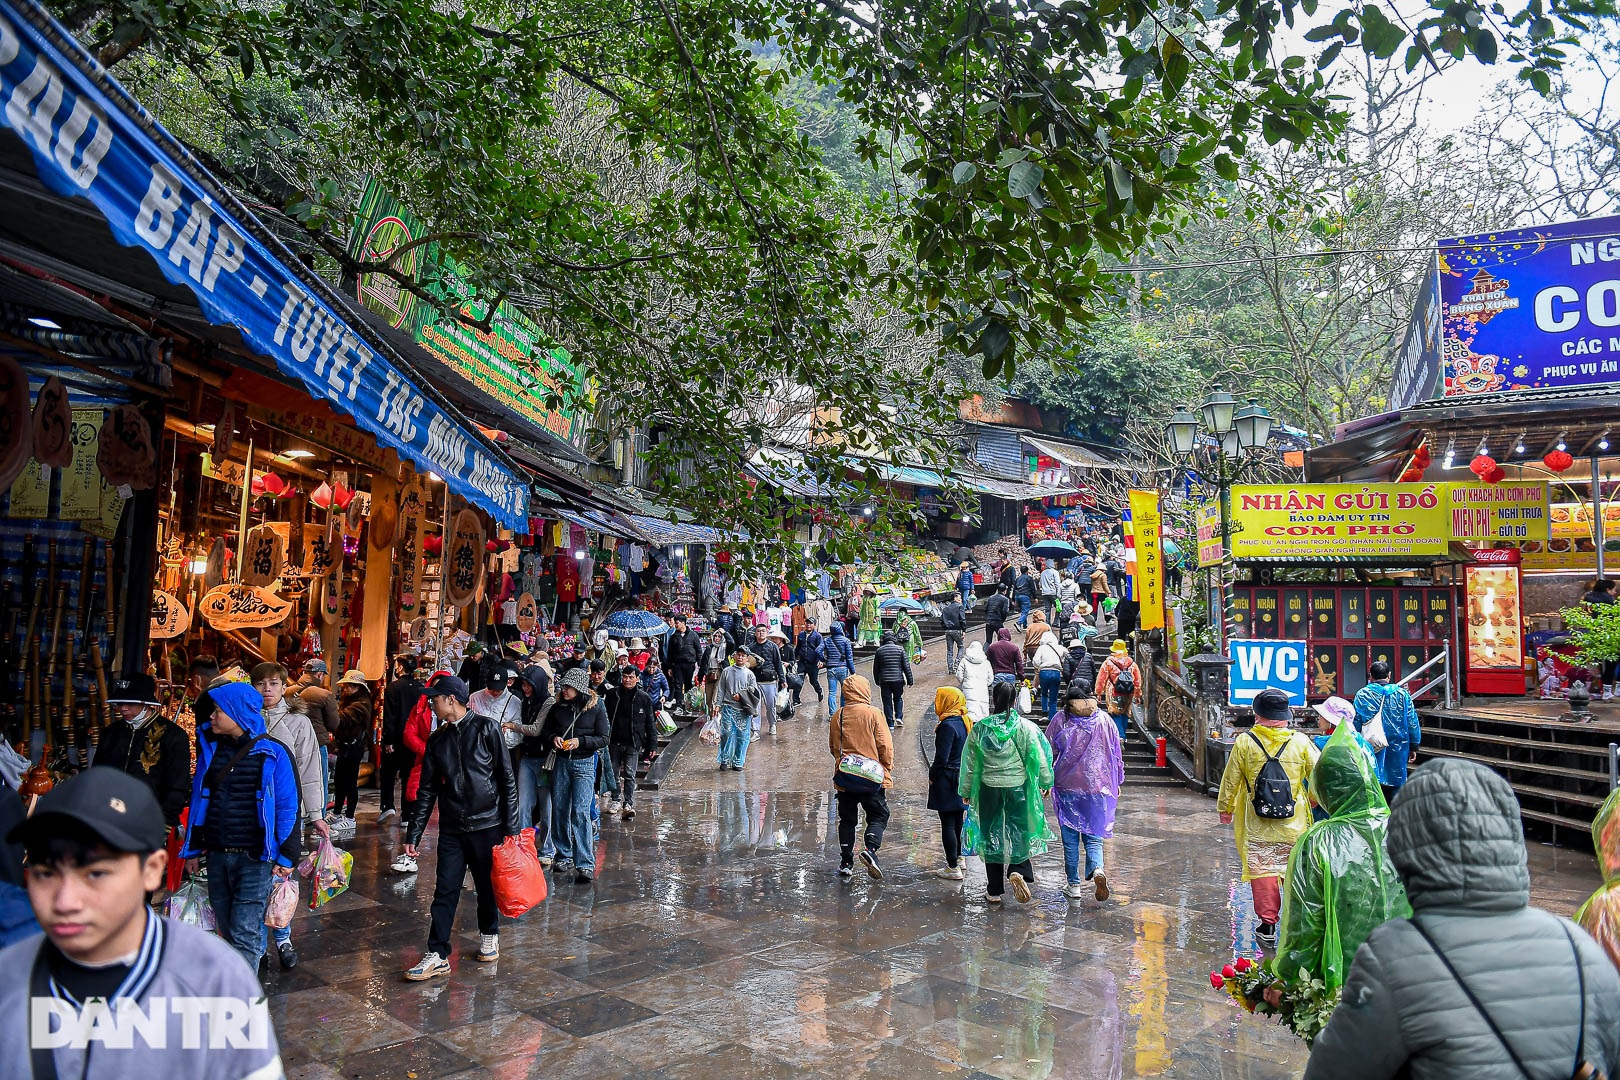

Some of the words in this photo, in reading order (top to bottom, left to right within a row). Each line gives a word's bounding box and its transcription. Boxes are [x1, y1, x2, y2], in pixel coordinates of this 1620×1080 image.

[434, 332, 459, 358] KHÔNG
[1562, 336, 1602, 356] CÁC
[1543, 364, 1577, 378] PHỤC
[1580, 362, 1597, 376] VỤ
[1600, 360, 1618, 373] ĂN
[1241, 490, 1326, 514] NHẬN
[1334, 487, 1390, 510] GỬI
[1396, 484, 1439, 510] ĐỒ
[1468, 486, 1493, 502] KHÁCH
[1508, 486, 1524, 502] CƠM
[1289, 512, 1314, 522] BẢO
[1317, 512, 1345, 522] ĐẢM
[1369, 512, 1390, 522] TÍN
[1452, 502, 1474, 537] MIỄN
[1476, 504, 1490, 536] PHÍ
[1498, 504, 1518, 518] NGHỈ
[1521, 506, 1542, 518] TRƯA
[1264, 525, 1336, 536] CƠM
[1347, 521, 1416, 536] PHỞ
[1499, 522, 1513, 536] GỬI
[1516, 522, 1527, 536] ĐỒ
[1258, 596, 1276, 611] NHẬN
[1314, 596, 1333, 610] HÀNH
[1350, 596, 1358, 610] LÝ
[1376, 596, 1386, 610] CÓ
[1404, 596, 1418, 610] BẢO
[1432, 595, 1446, 610] ĐẢM
[1236, 646, 1299, 682] WC
